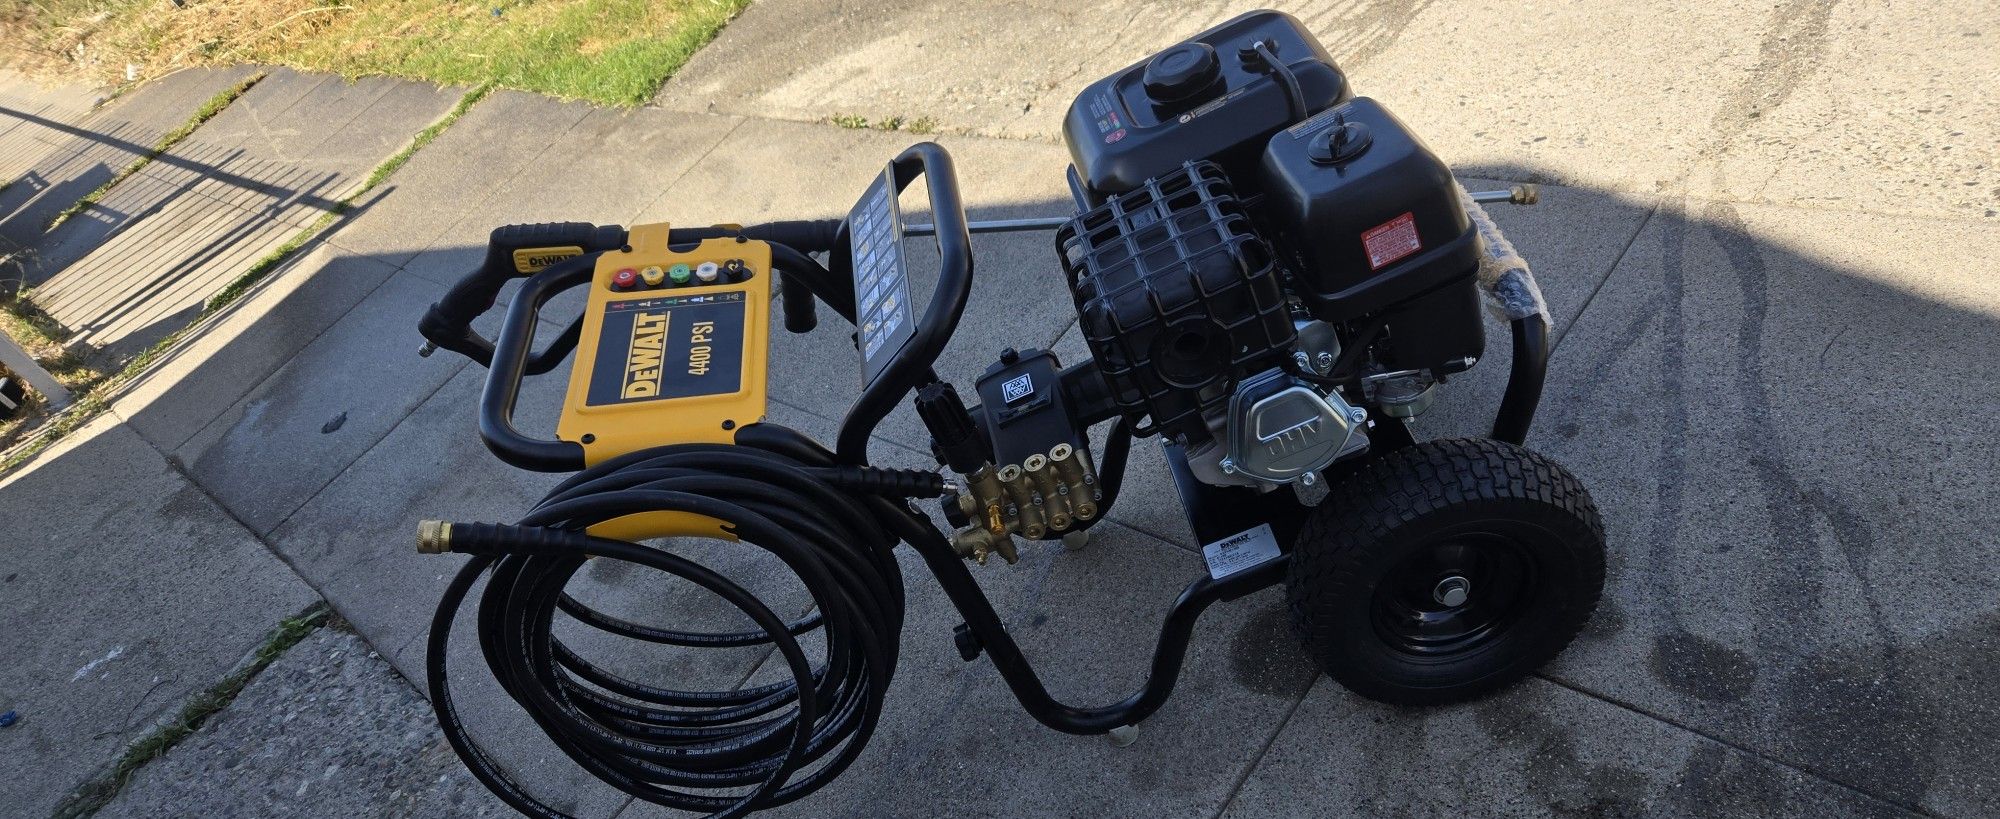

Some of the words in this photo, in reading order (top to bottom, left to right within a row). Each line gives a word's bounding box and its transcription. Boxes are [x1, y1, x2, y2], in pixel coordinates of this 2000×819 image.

[528, 255, 573, 265] DEWA
[691, 321, 714, 343] PSI
[624, 312, 667, 399] DEWALT
[688, 346, 712, 376] 4400
[1220, 533, 1251, 549] DEWALT
